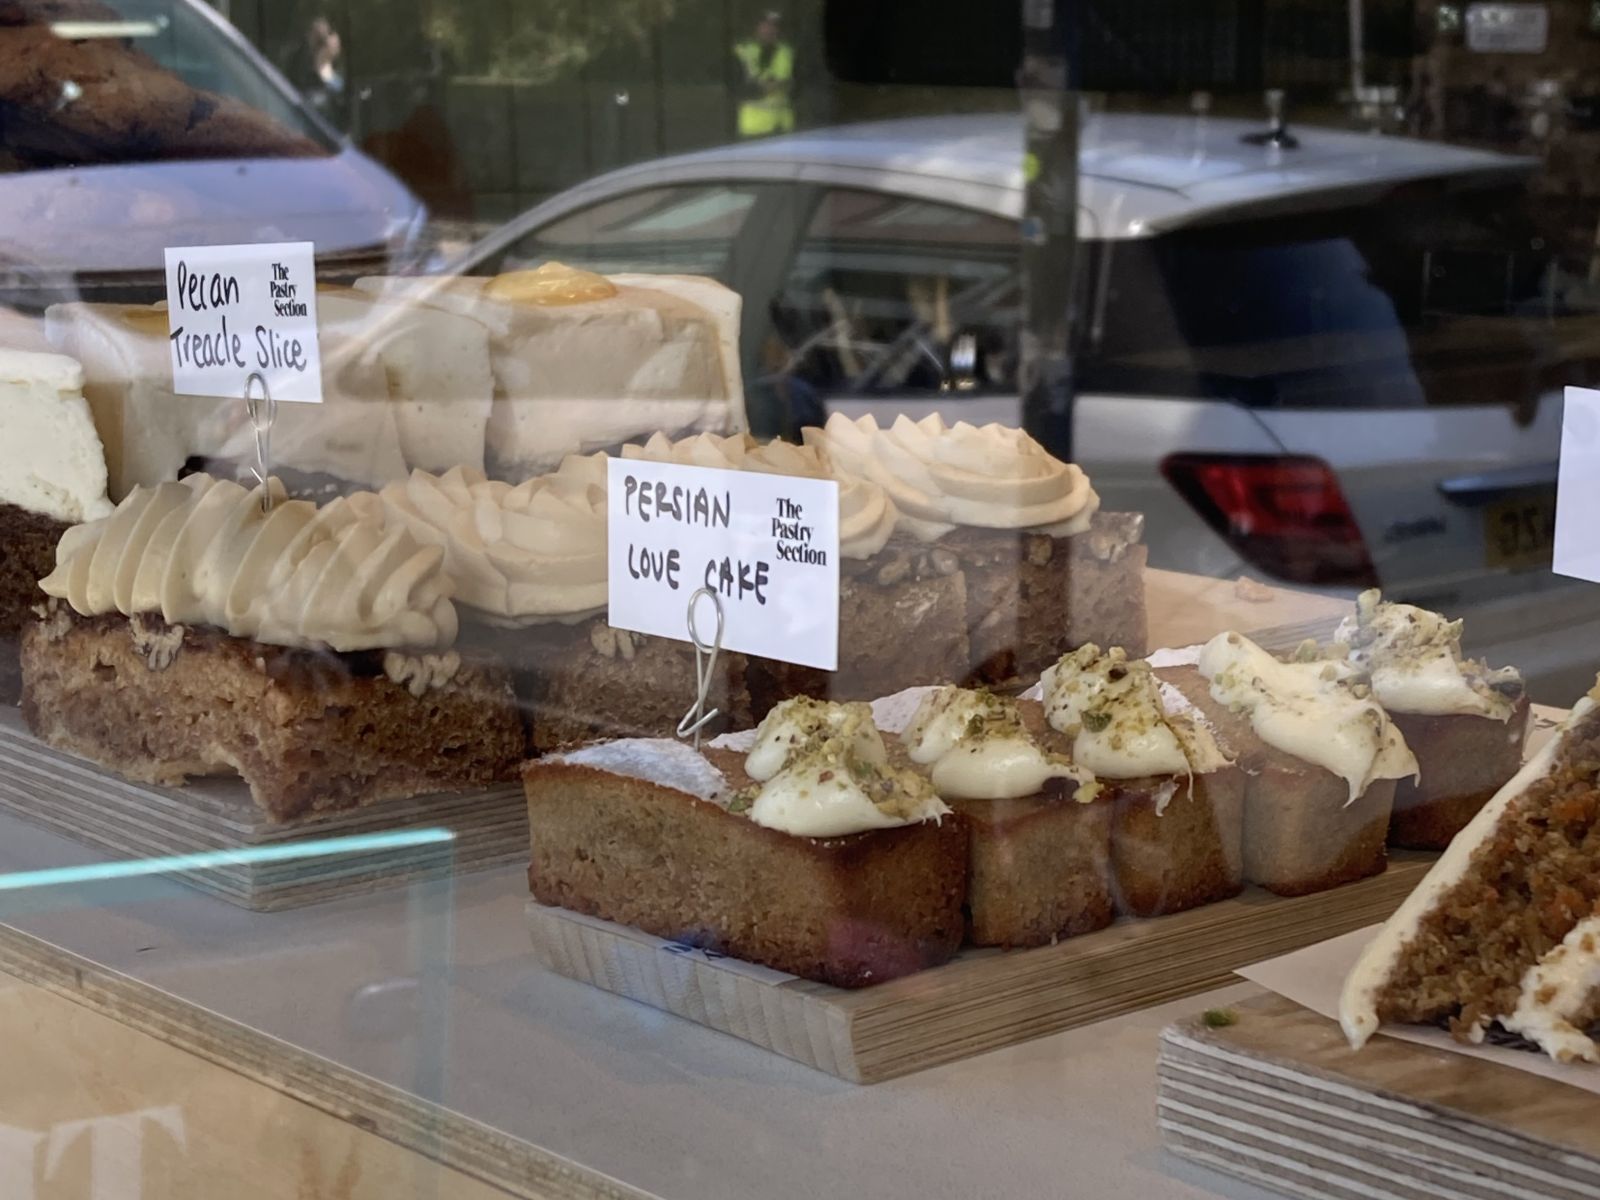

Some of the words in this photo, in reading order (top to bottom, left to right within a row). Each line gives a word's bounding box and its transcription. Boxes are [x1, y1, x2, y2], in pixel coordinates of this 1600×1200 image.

[271, 262, 289, 280] The
[177, 260, 240, 312] Pecan
[270, 281, 297, 299] Pastry
[274, 299, 307, 317] Section
[170, 315, 246, 369] Treacle
[255, 325, 307, 372] Slice
[624, 475, 730, 528] PERSIAN
[776, 497, 803, 520] The
[771, 517, 814, 543] Pastry
[776, 540, 827, 567] Section
[628, 543, 681, 590] LOVE
[704, 556, 769, 605] CAKE
